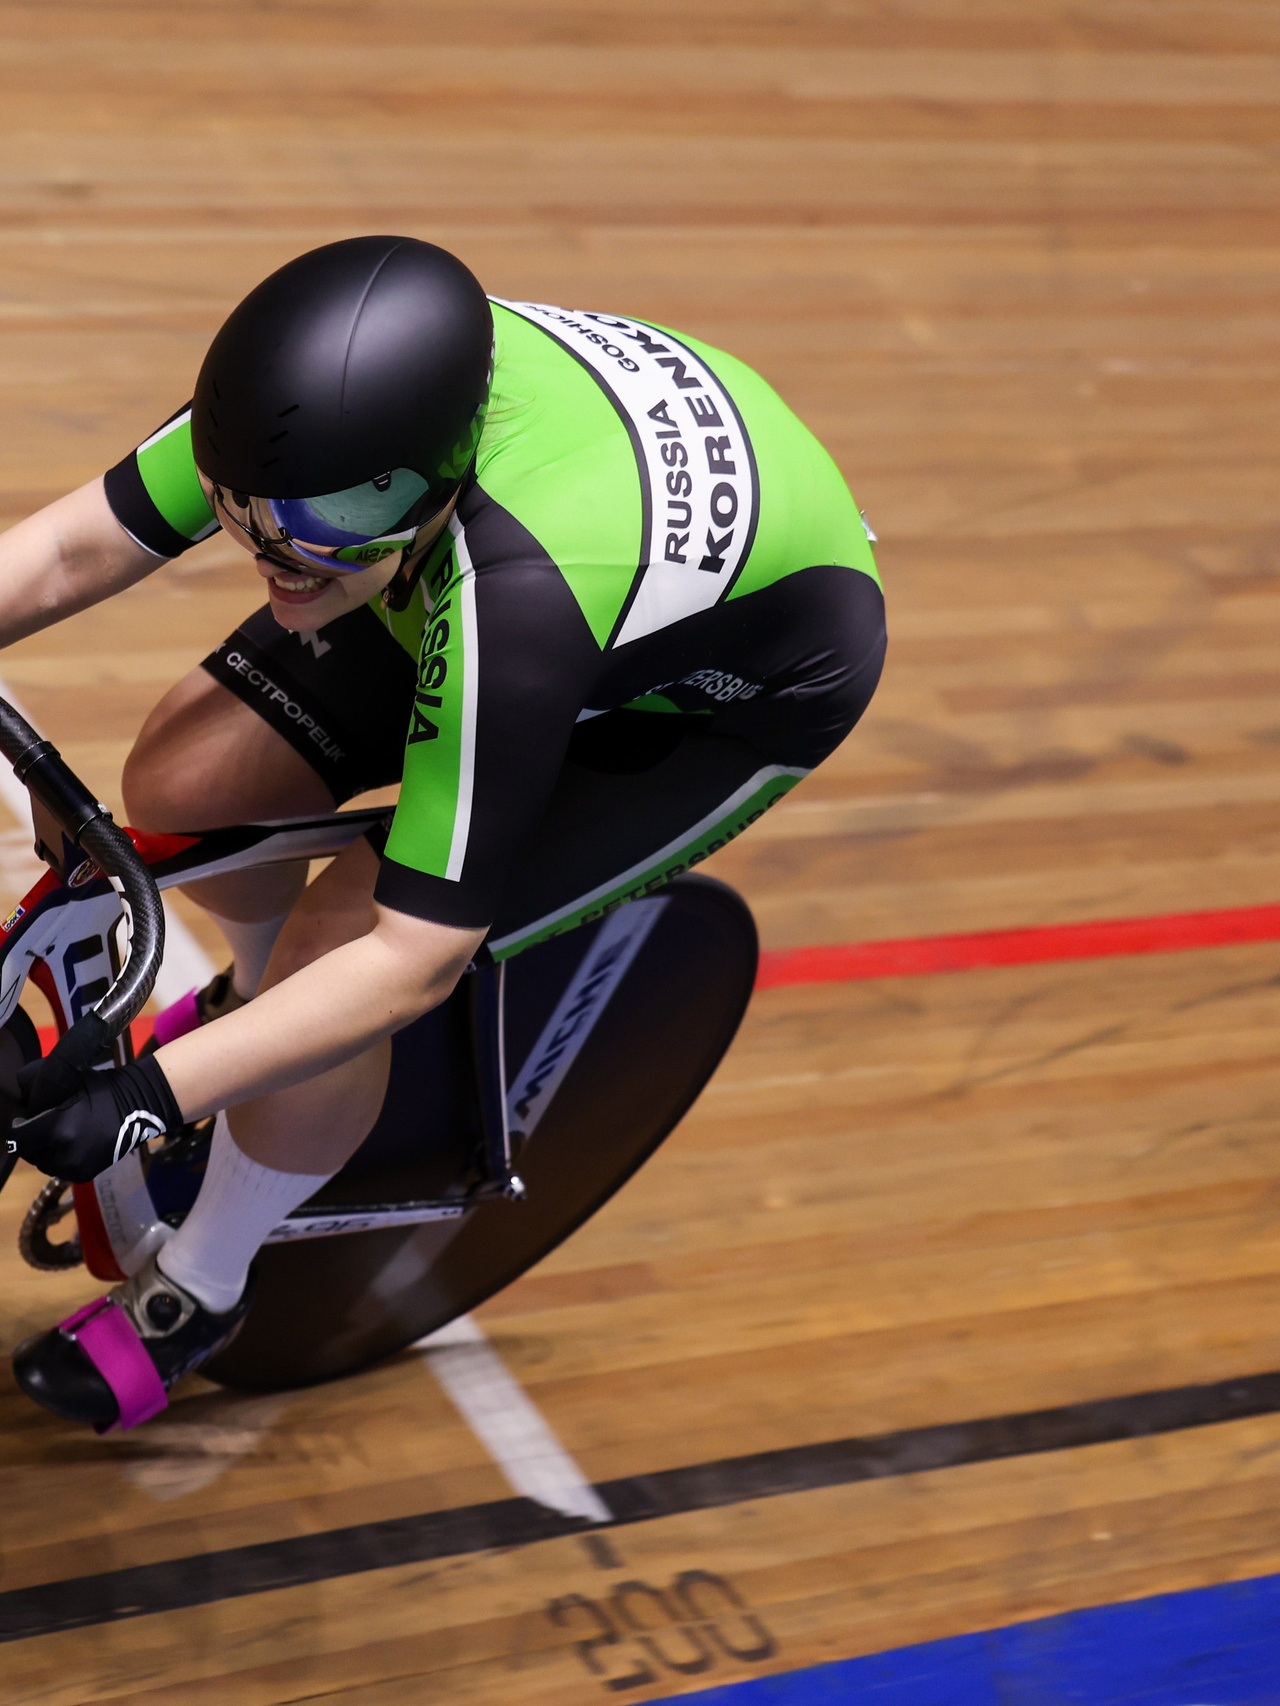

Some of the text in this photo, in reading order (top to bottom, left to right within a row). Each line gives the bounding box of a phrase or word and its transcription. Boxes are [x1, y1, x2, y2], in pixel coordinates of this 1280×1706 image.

[560, 306, 739, 575] KORENKO
[646, 398, 693, 565] RUSSIA
[226, 651, 346, 763] СЕСТРОРЕЦК
[3, 913, 20, 932] LOOK
[546, 1569, 780, 1692] 200
